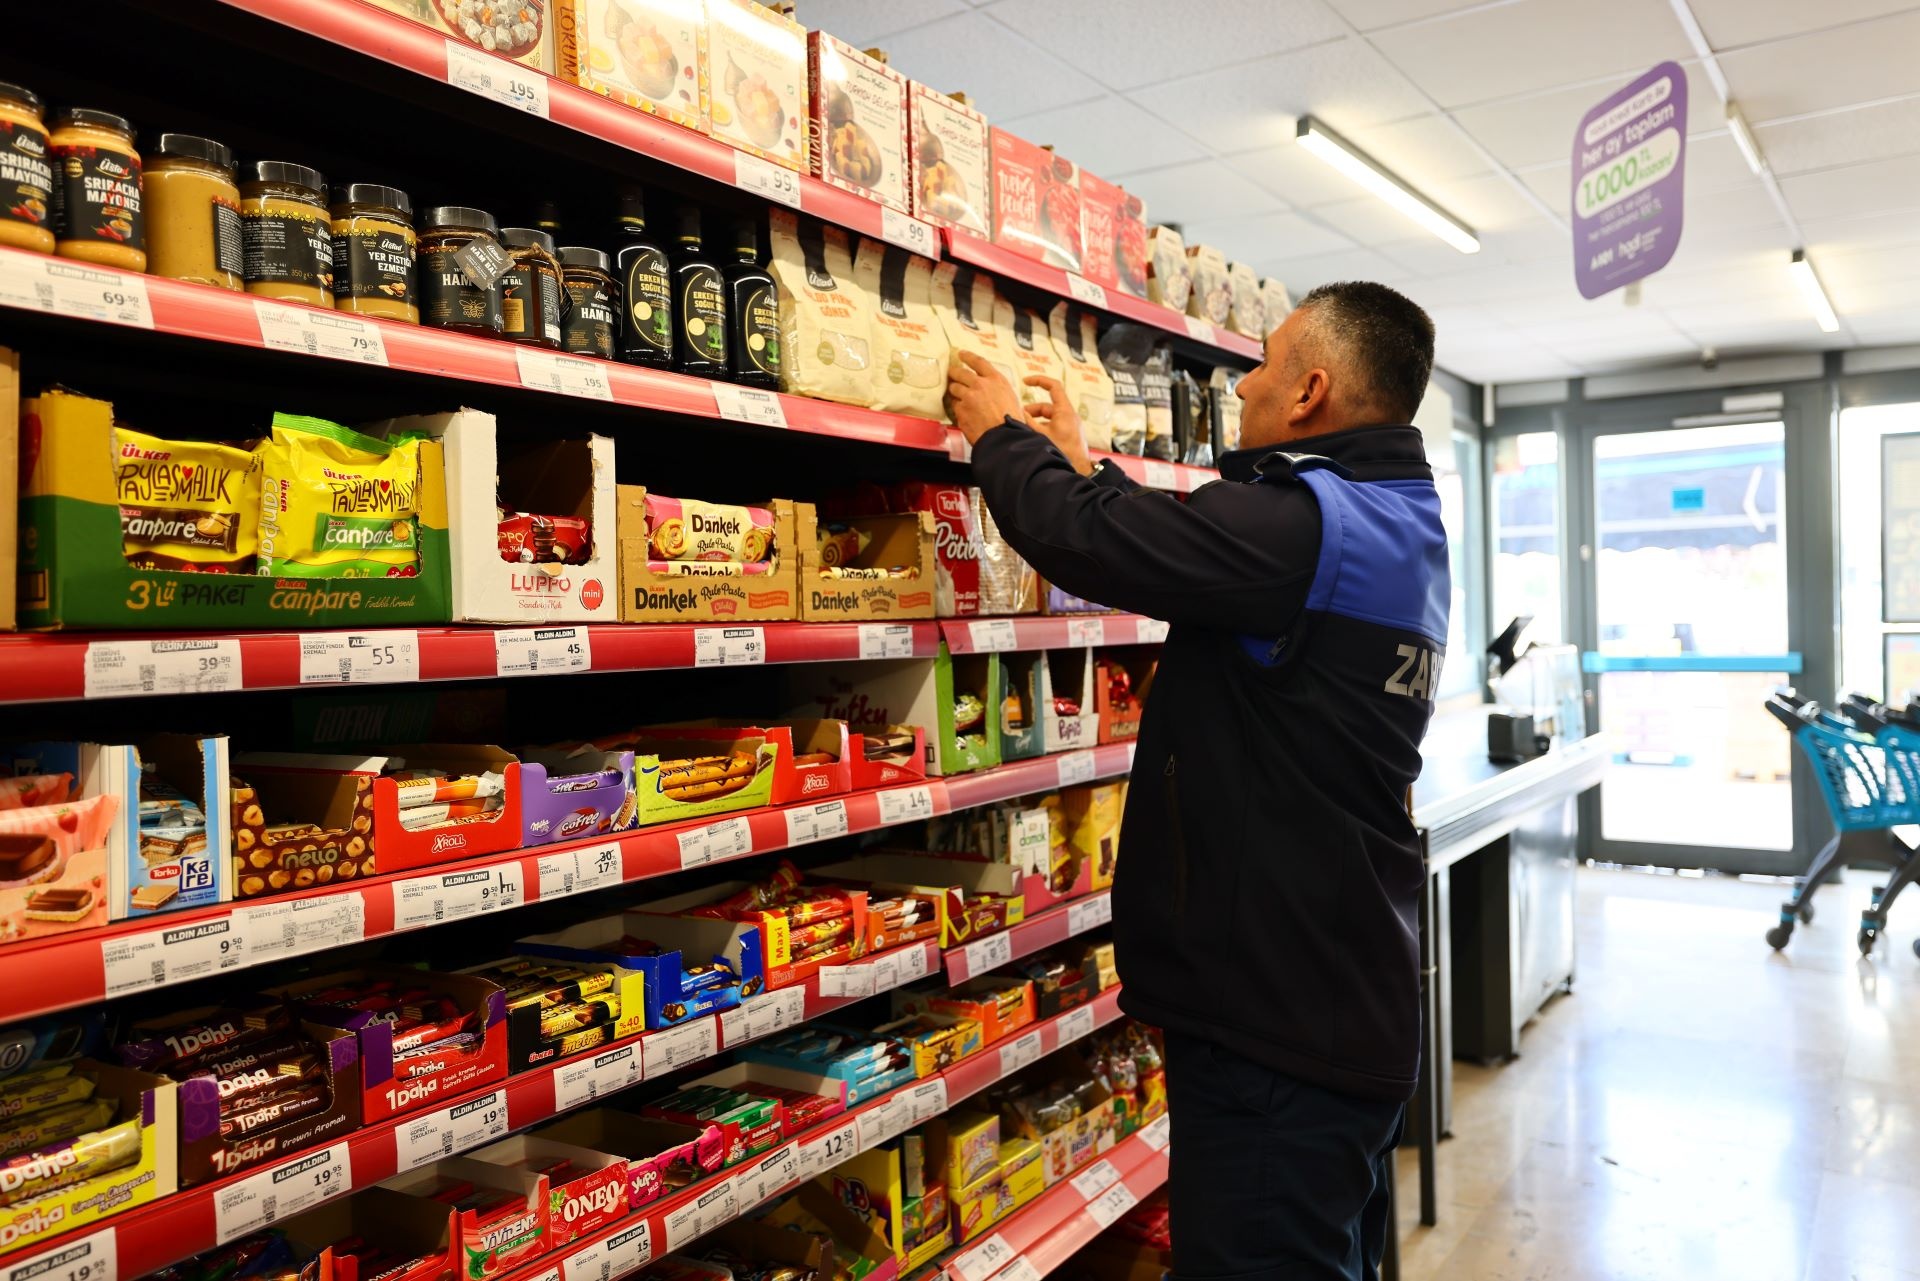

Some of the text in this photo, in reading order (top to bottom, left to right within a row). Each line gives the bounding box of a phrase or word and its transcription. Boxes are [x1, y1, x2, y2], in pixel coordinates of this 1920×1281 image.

[509, 79, 535, 100] 195
[84, 176, 140, 201] SRIRACHA
[773, 171, 793, 193] 99
[86, 190, 140, 213] MAYONEZ
[909, 223, 924, 243] 99
[369, 251, 387, 262] YER
[581, 307, 604, 321] HAM
[121, 444, 172, 461] ÜLKER
[280, 479, 290, 513] ÜLKER
[257, 477, 280, 577] canpare
[692, 515, 740, 537] Dankek
[325, 526, 393, 549] canpare
[715, 538, 735, 553] Pasta
[274, 578, 308, 590] ÜLKER
[511, 574, 571, 592] LUPPO
[721, 583, 746, 599] Pasta
[269, 588, 361, 617] canpare
[583, 589, 600, 598] mini
[635, 587, 697, 613] Dankek
[811, 591, 859, 611] Dankek
[537, 632, 555, 640] ALDIN
[372, 645, 395, 666] 55
[567, 643, 581, 654] 45
[802, 775, 829, 793] XROLL
[911, 791, 926, 808] 14
[530, 819, 550, 832] Milka
[561, 811, 600, 832] GoFree
[432, 834, 466, 853] XROLL
[284, 848, 338, 869] nello
[153, 867, 178, 877] Torku
[445, 872, 488, 886] ALDIN ALDIN!
[167, 922, 228, 943] ALDIN ALDIN!
[775, 927, 784, 959] Maxi
[551, 1018, 575, 1033] metro
[620, 1015, 640, 1030] %40
[564, 1032, 599, 1054] metro
[597, 1048, 632, 1068] ALDIN ALDIN!
[629, 1061, 636, 1071] 4
[452, 1095, 495, 1118] ALDIN ALDIN!
[282, 1130, 313, 1149] Browni
[314, 1114, 346, 1134] Aromalı
[275, 1154, 329, 1182] ALDIN ALDIN!
[521, 1231, 536, 1243] TIME
[609, 1237, 626, 1249] ALDIN
[637, 1240, 649, 1253] 15
[983, 1243, 999, 1262] 19
